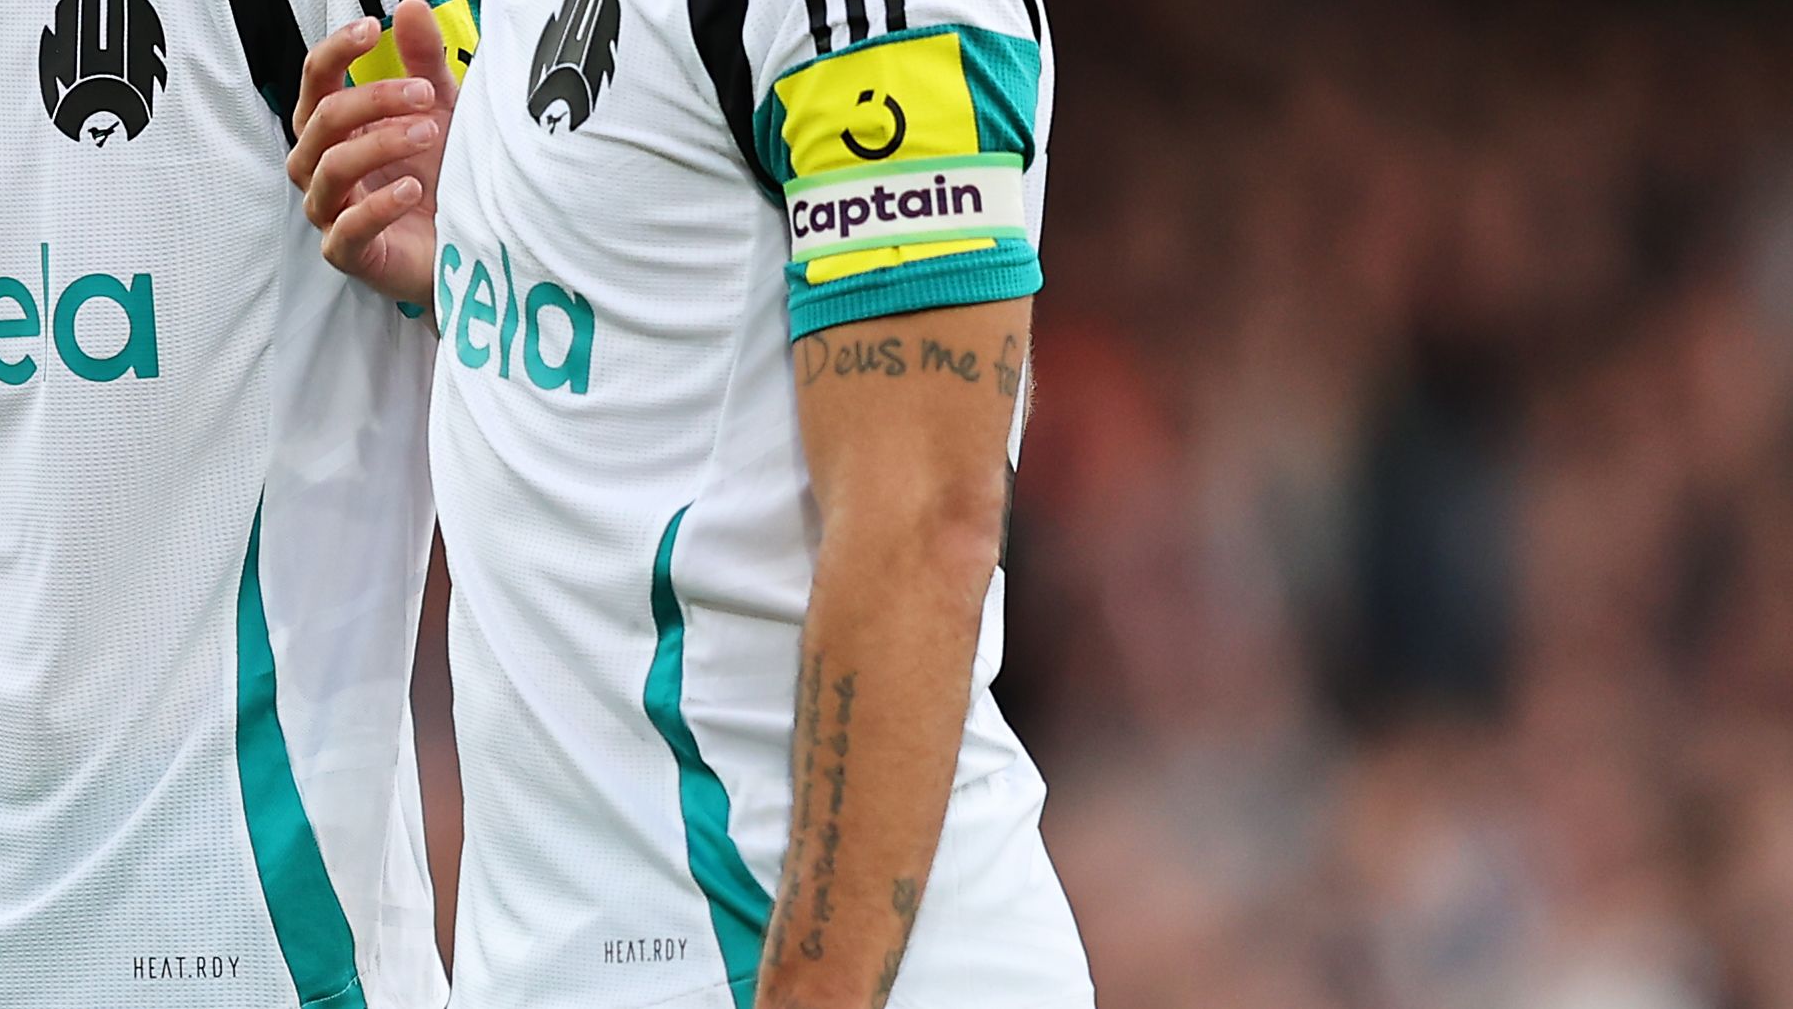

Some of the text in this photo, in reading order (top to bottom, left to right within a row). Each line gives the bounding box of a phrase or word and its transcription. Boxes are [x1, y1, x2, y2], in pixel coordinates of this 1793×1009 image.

[792, 174, 983, 239] Captain
[437, 240, 596, 396] sela
[802, 331, 905, 386] Deus
[920, 339, 981, 383] me
[132, 955, 240, 980] HEAT.RDY
[603, 937, 688, 964] HEAT.RDY
